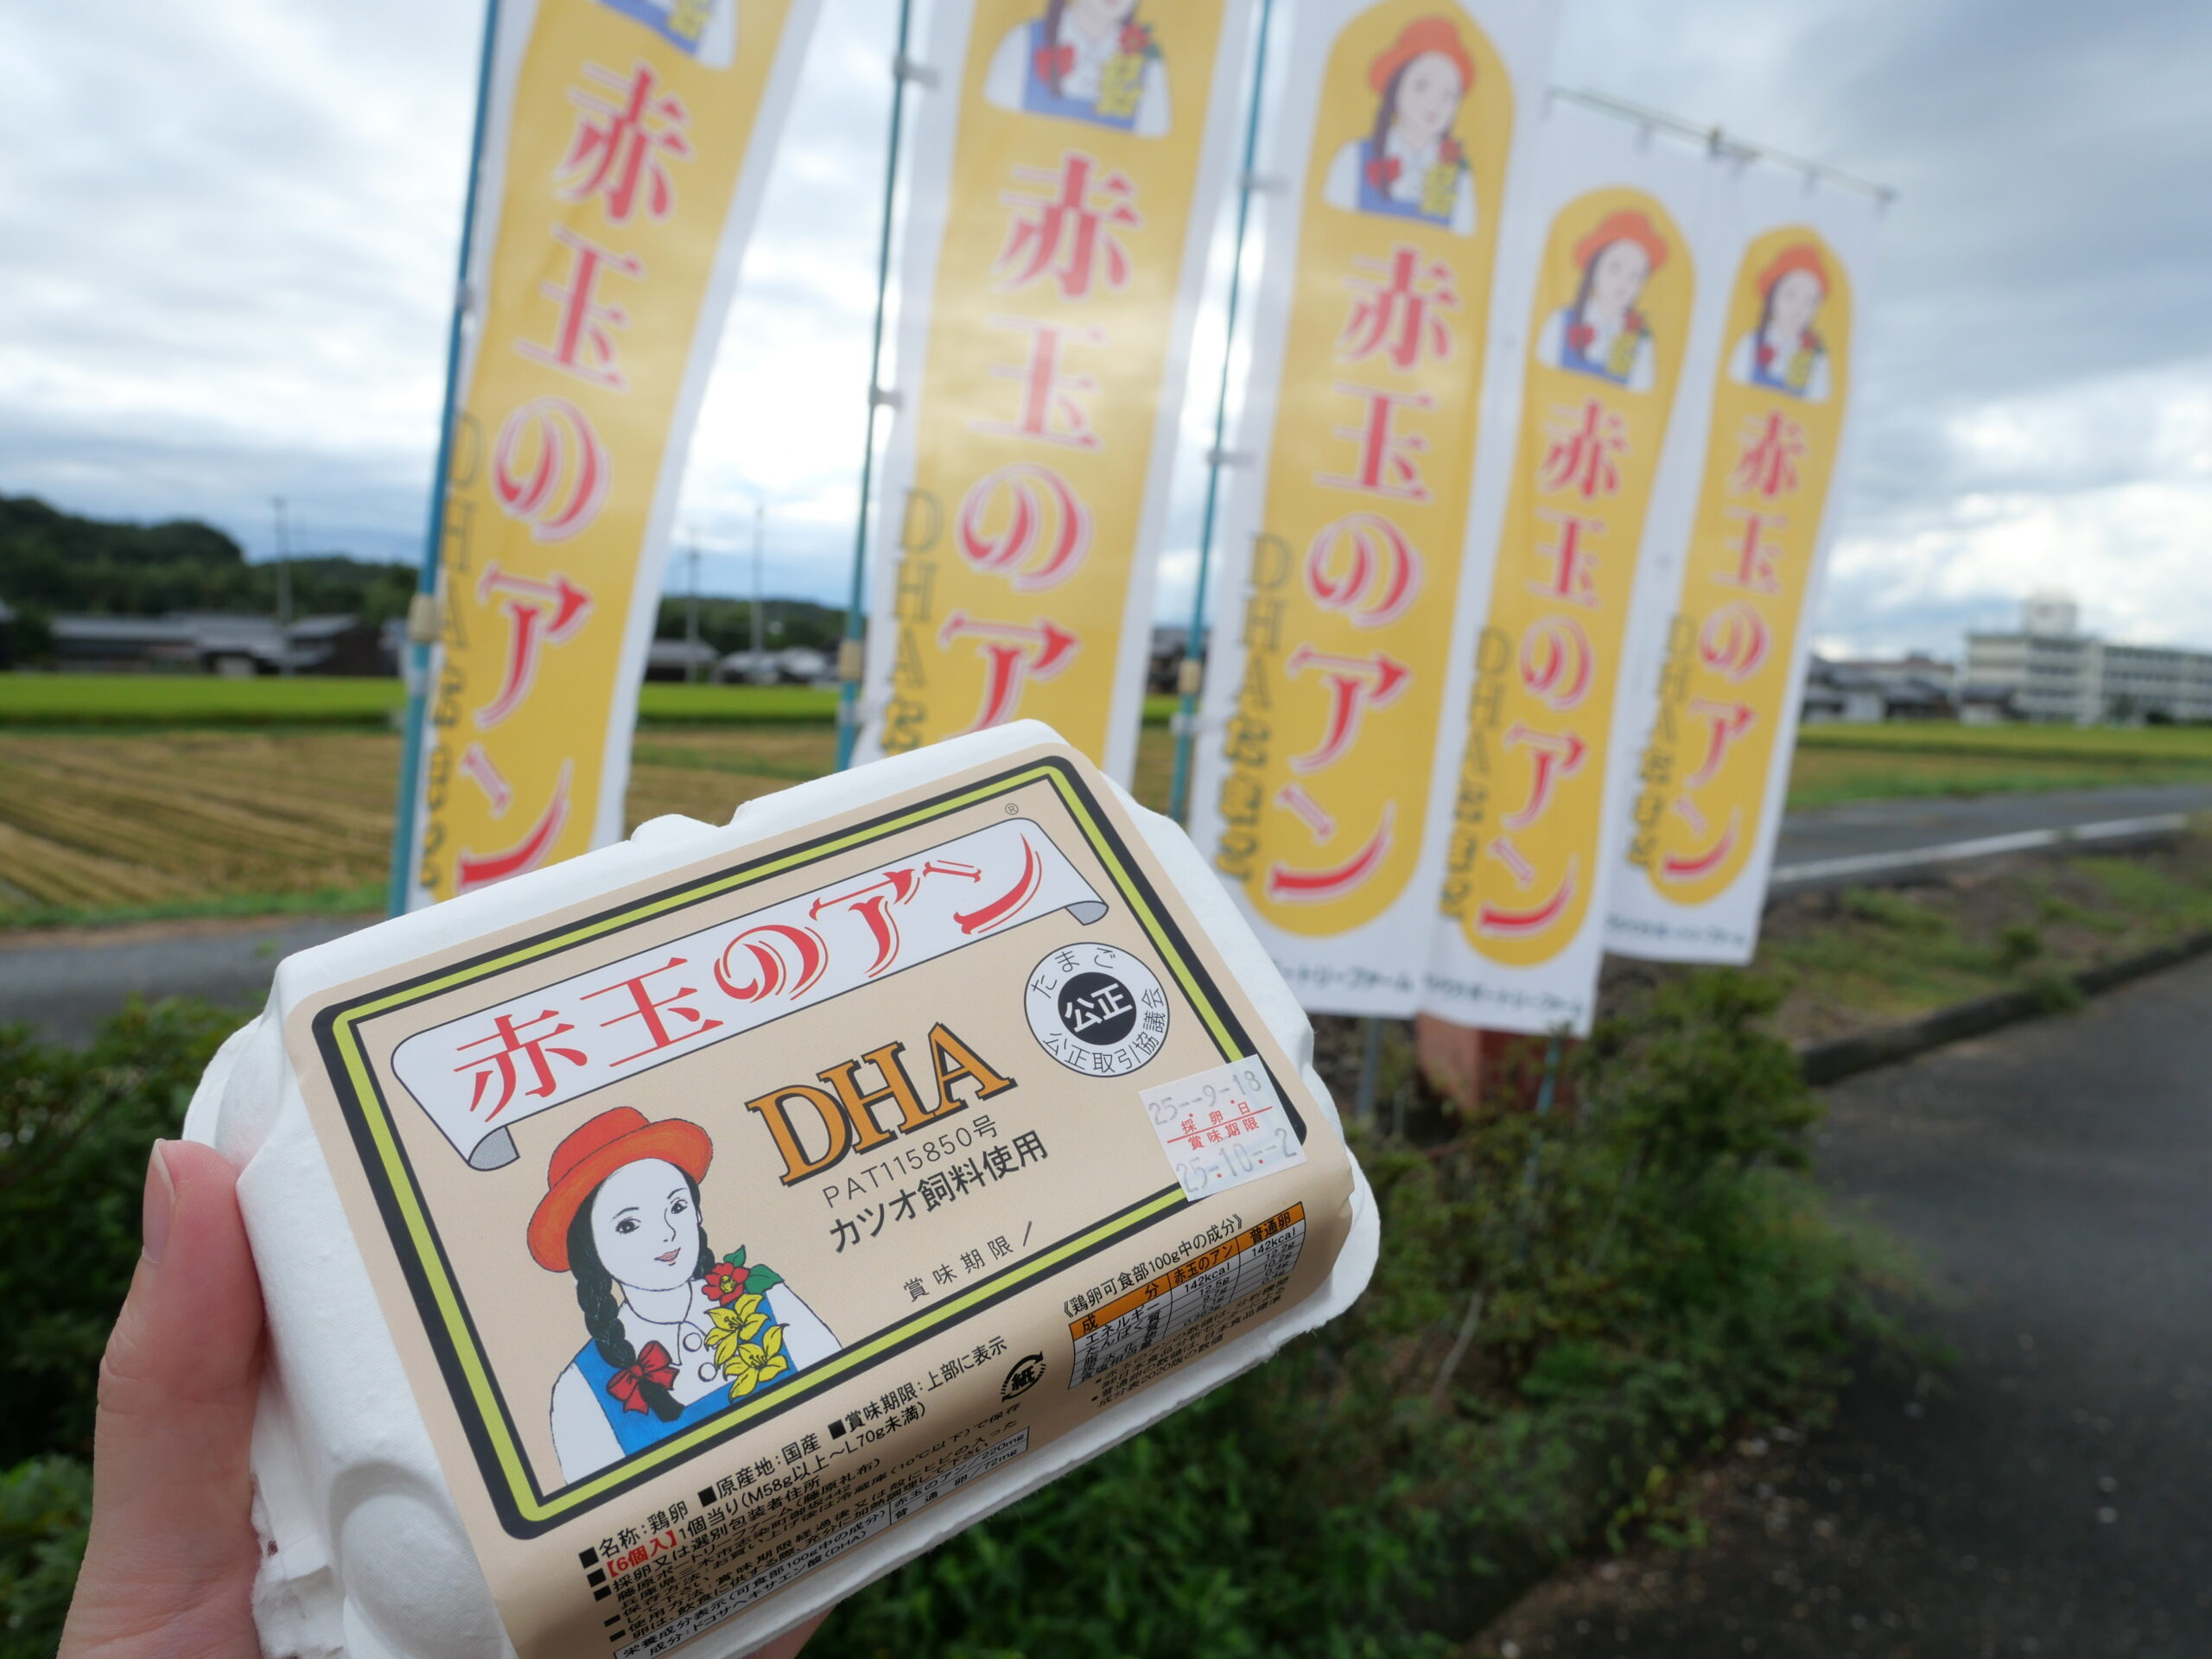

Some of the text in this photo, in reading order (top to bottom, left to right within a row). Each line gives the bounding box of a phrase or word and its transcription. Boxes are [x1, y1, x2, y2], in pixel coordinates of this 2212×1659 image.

[453, 62, 694, 893] 赤玉のアン
[938, 149, 1143, 742] 赤玉のア
[1266, 244, 1462, 902] 赤玉のアン
[1477, 397, 1630, 938] 赤玉のアン
[1661, 410, 1808, 881] 赤玉のアン
[454, 832, 1042, 1122] 赤玉のアン
[1032, 948, 1119, 1001] たまご
[1041, 984, 1166, 1076] 公正取引協議会
[1061, 981, 1133, 1034] 公正
[745, 1021, 1018, 1187] DHA
[823, 1113, 1001, 1208] PAT115850号
[1187, 1116, 1260, 1151] 賞味期限
[825, 1128, 1049, 1254] カツオ飼料使用
[1172, 1242, 1236, 1285] 赤玉のアン
[1248, 1211, 1294, 1245] 普通卵
[1084, 1226, 1297, 1346] エネルギー 142kcal 142kcal
[1007, 1365, 1036, 1391] 紙
